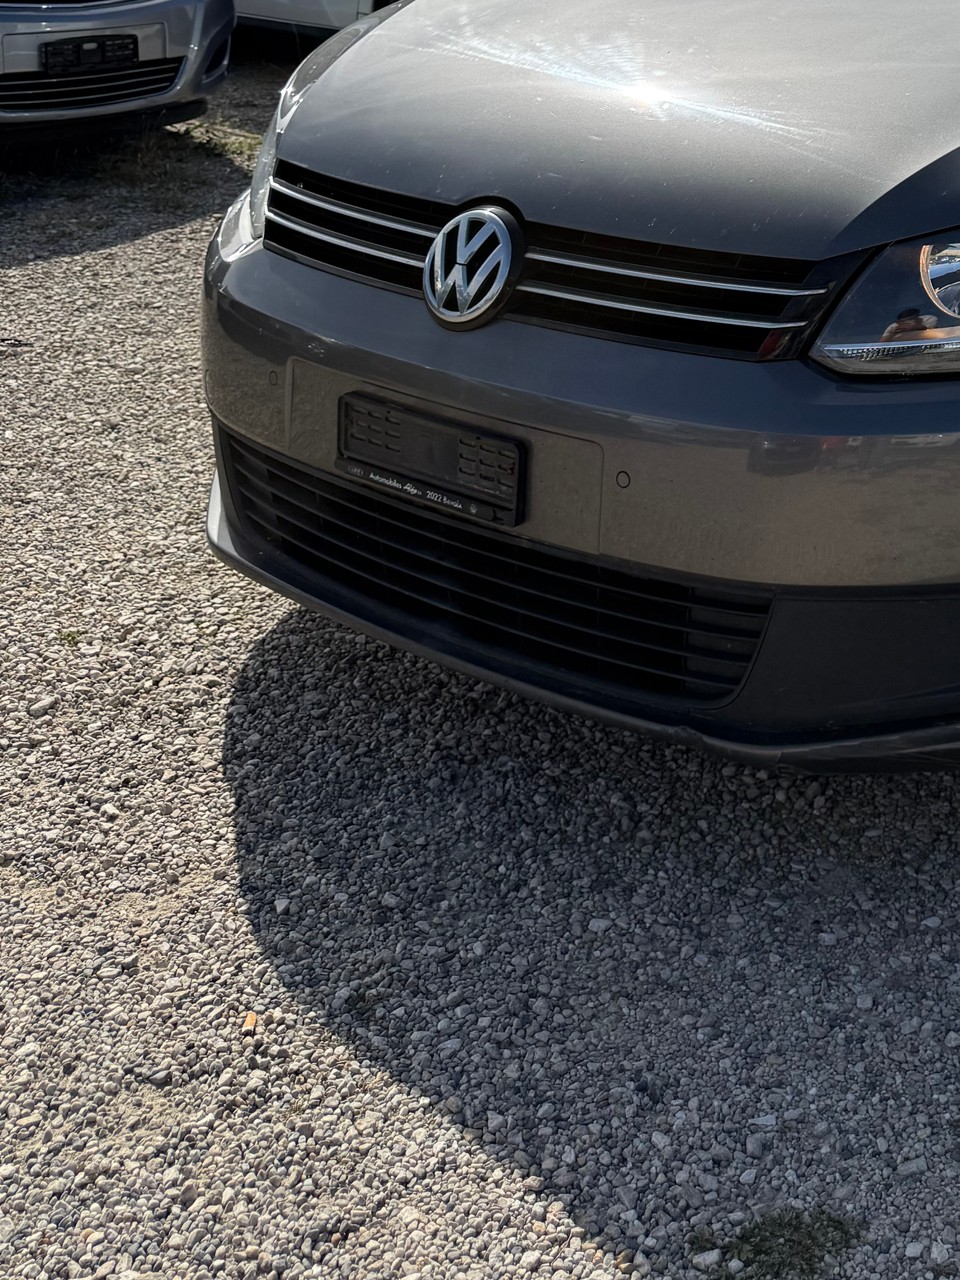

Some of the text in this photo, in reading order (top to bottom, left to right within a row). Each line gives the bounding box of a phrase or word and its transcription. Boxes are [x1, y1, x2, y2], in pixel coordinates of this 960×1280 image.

[430, 213, 508, 318] VW
[369, 472, 402, 489] Automobiles
[426, 490, 442, 503] 2022
